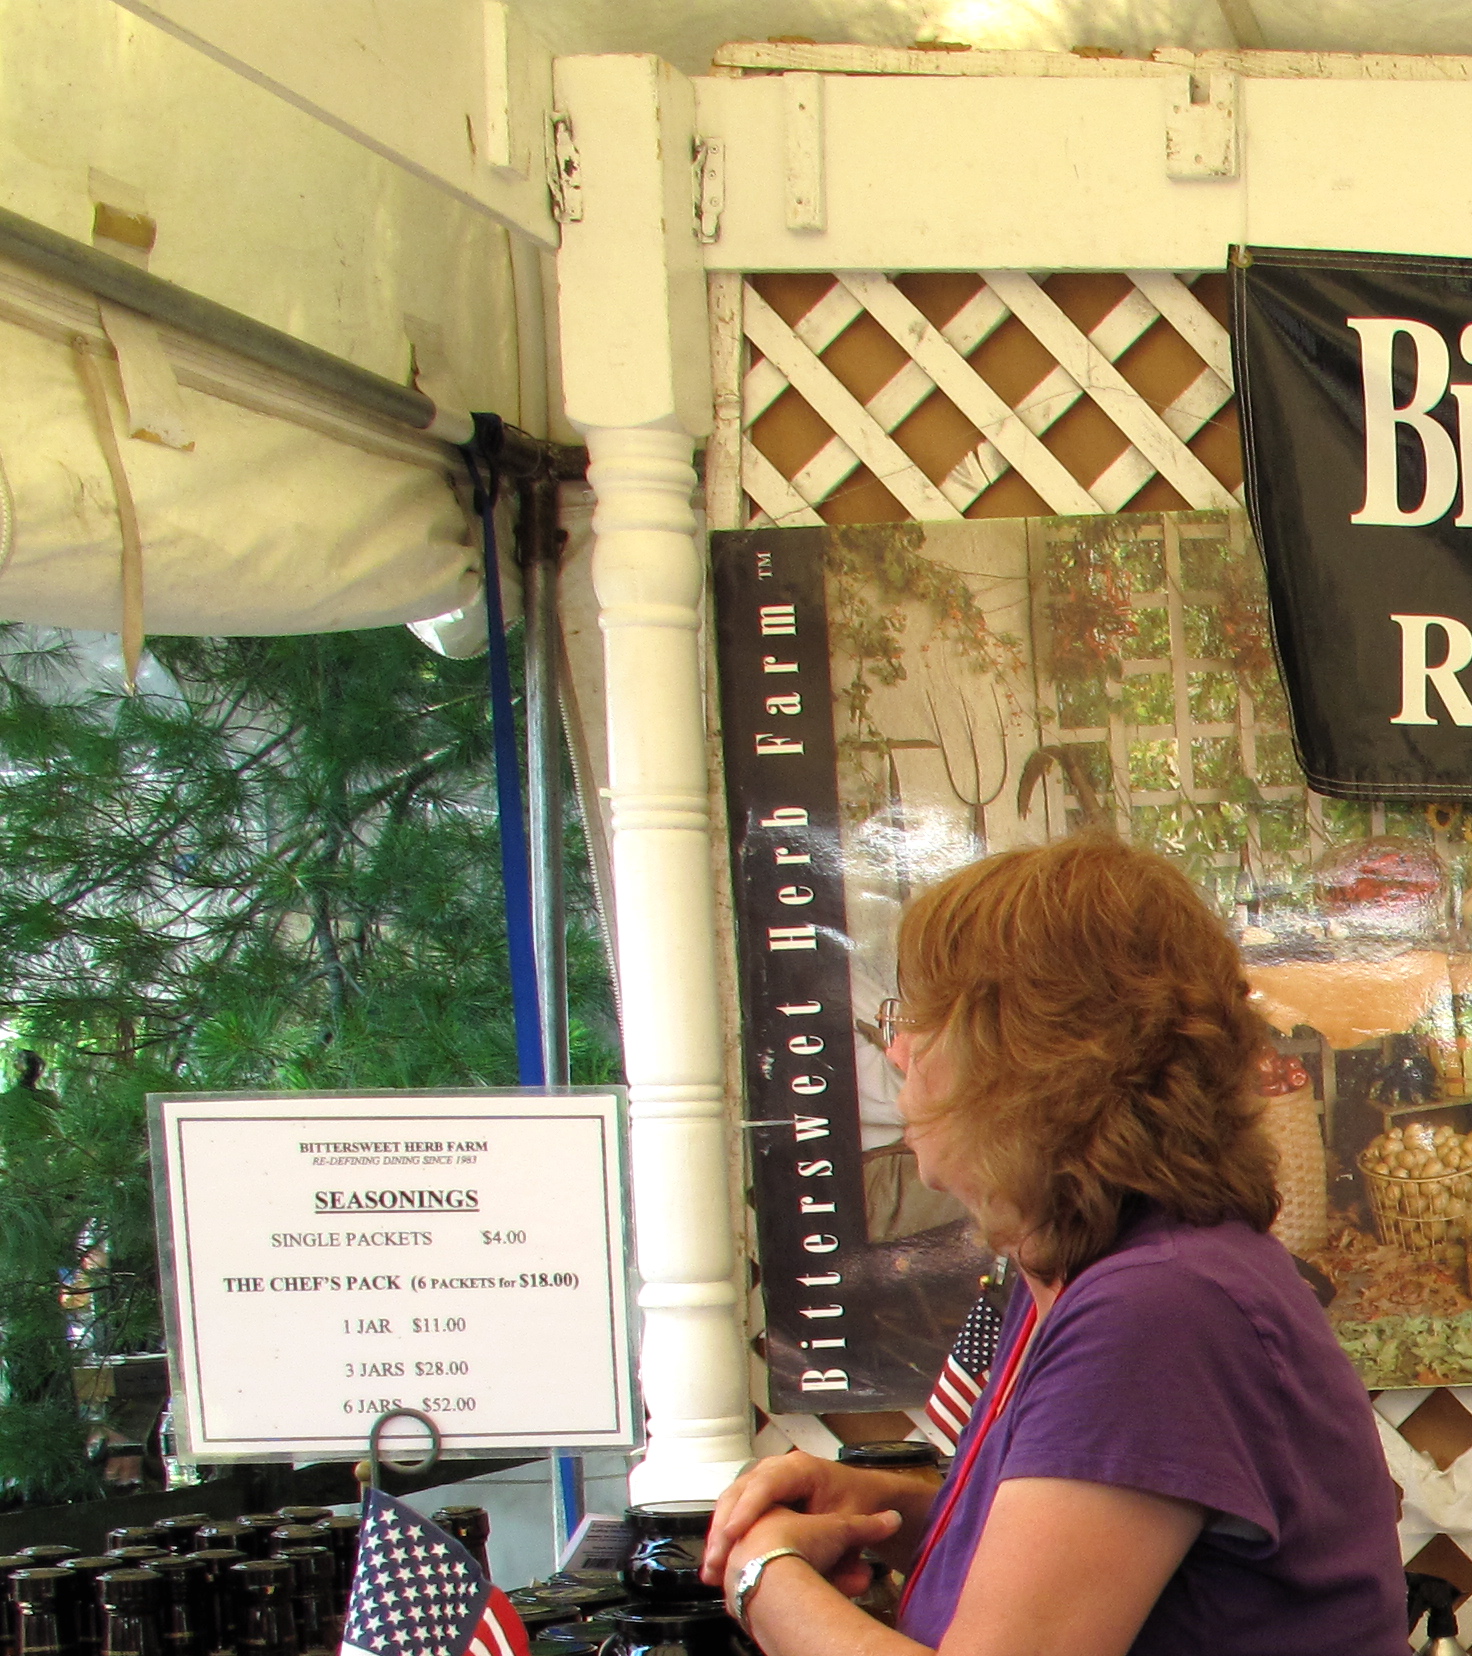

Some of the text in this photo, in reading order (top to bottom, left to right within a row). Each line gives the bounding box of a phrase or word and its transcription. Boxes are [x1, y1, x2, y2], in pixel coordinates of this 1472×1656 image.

[756, 603, 805, 756] Farm
[760, 805, 817, 952] Herb
[300, 1141, 488, 1153] BITTERSWEET HERB FARM
[313, 1155, 380, 1166] RE-DEFINING
[383, 1155, 421, 1165] DINING
[423, 1155, 453, 1165] SINCE
[315, 1189, 479, 1210] SEASONINGS
[775, 997, 850, 1394] Bittersweet
[272, 1230, 526, 1247] SINGLE PACKETS $4.00
[223, 1273, 579, 1292] THE CHEF'S PACK (6 PACKETS for $18.00)
[344, 1316, 466, 1334] 1 JAR $11.00
[345, 1360, 469, 1377] 3 JARS $28.00
[343, 1396, 476, 1413] 6 JARS $52.00
